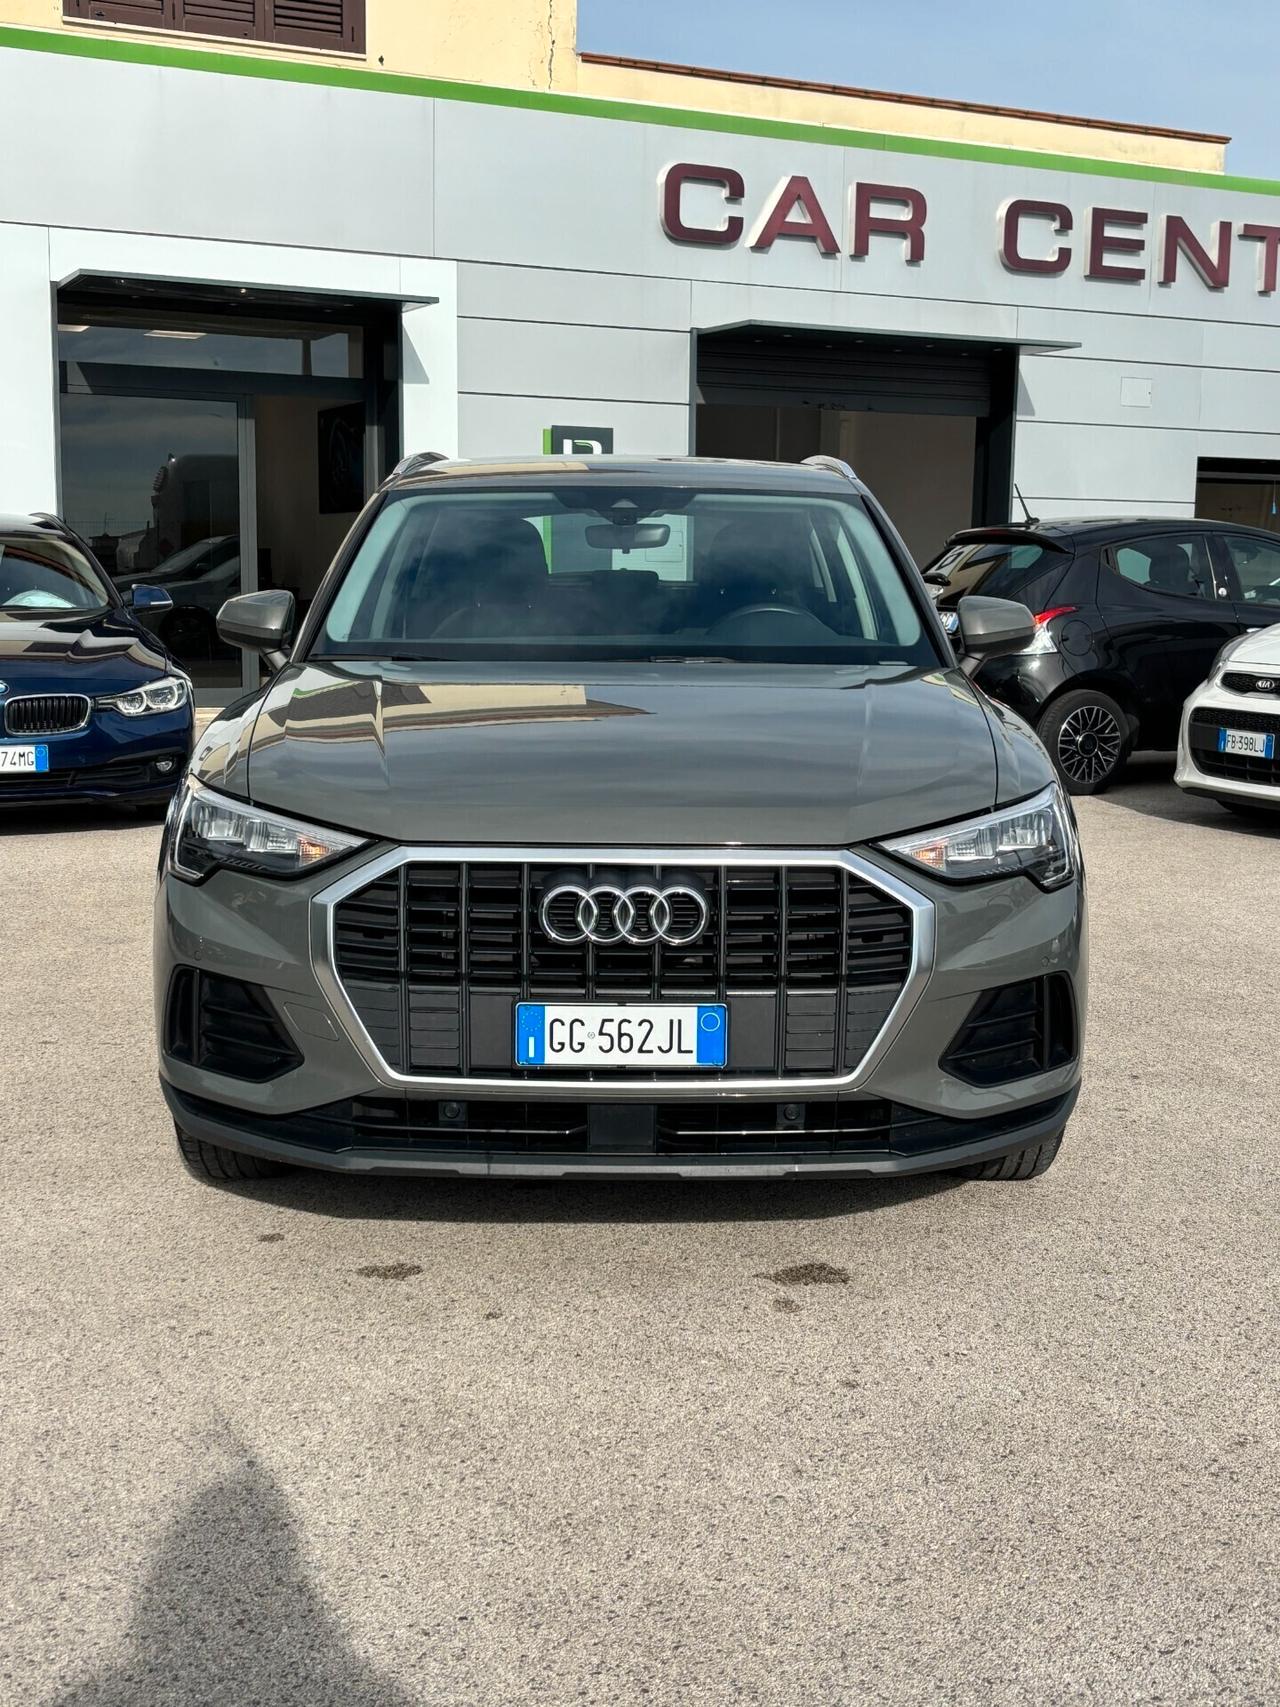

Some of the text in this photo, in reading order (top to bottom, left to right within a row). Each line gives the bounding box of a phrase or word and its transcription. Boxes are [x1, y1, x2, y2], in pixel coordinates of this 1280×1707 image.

[658, 162, 1280, 294] CAR CENT
[1257, 680, 1272, 689] KIA
